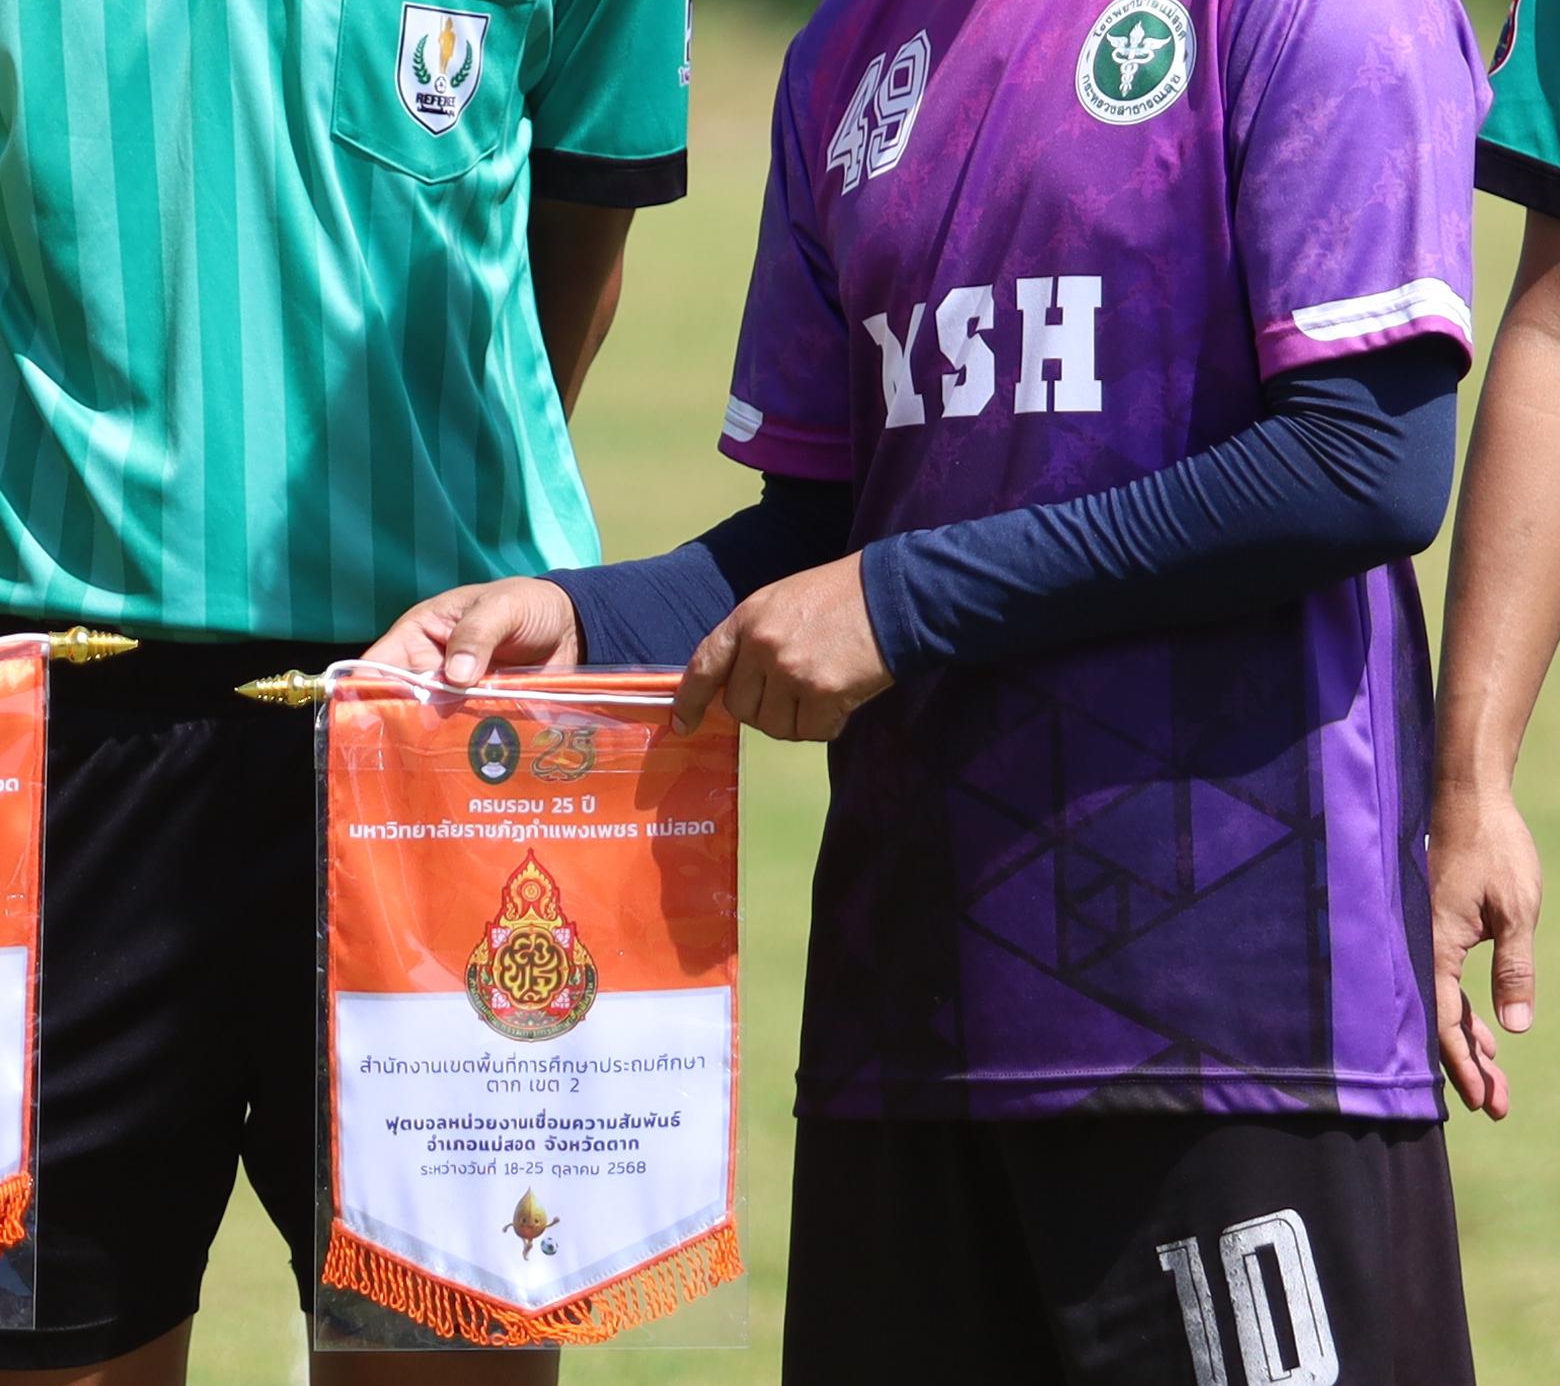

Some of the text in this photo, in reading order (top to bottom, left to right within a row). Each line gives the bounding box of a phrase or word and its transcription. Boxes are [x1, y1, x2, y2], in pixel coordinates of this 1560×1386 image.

[416, 93, 456, 107] REFEREE
[826, 29, 932, 197] 49
[468, 794, 596, 814] ครบรอบ 25 ปี
[349, 818, 715, 843] มหาวิทยาลัยราชภัฏกำแพงเพชร แม่สอด
[359, 1052, 706, 1075] สำนักงานเขตพื้นที่การศึกษาประถมศึกษา
[486, 1077, 581, 1093] ตาก เขต 2
[385, 1109, 682, 1135] ฟุตบอลหน่วยงานเชื่อมความสัมพันธ์
[426, 1133, 640, 1153] อำเภอแม่สอด จังหวัดตาก
[420, 1160, 647, 1178] ระหว่างวันที่ 18-25 ตุลาคม 2568
